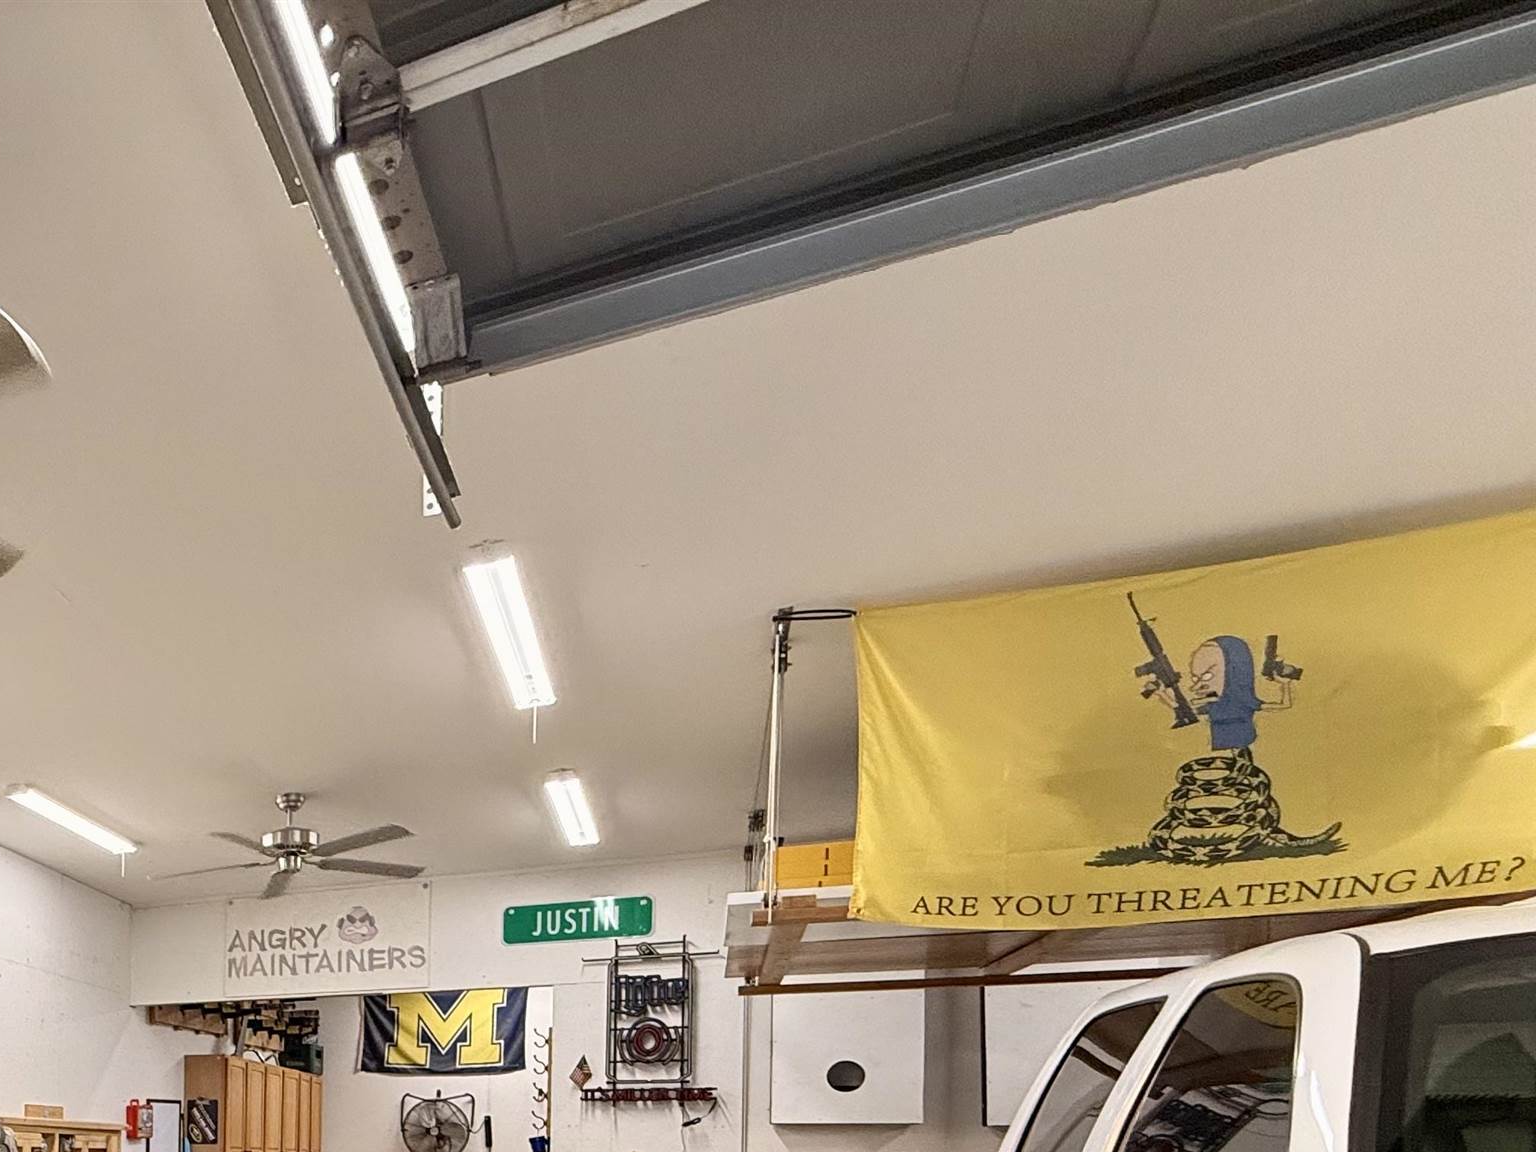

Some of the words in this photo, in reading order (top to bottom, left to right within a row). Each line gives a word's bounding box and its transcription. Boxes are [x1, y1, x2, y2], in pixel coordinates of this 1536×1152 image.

[910, 896, 979, 917] ARE
[991, 894, 1074, 916] YOU
[1087, 869, 1417, 914] THREATENING
[1426, 856, 1526, 890] ME?
[228, 924, 327, 952] ANGRY
[531, 904, 620, 937] JUSTIN
[227, 945, 427, 980] MAINTAINERS
[384, 989, 507, 1069] M
